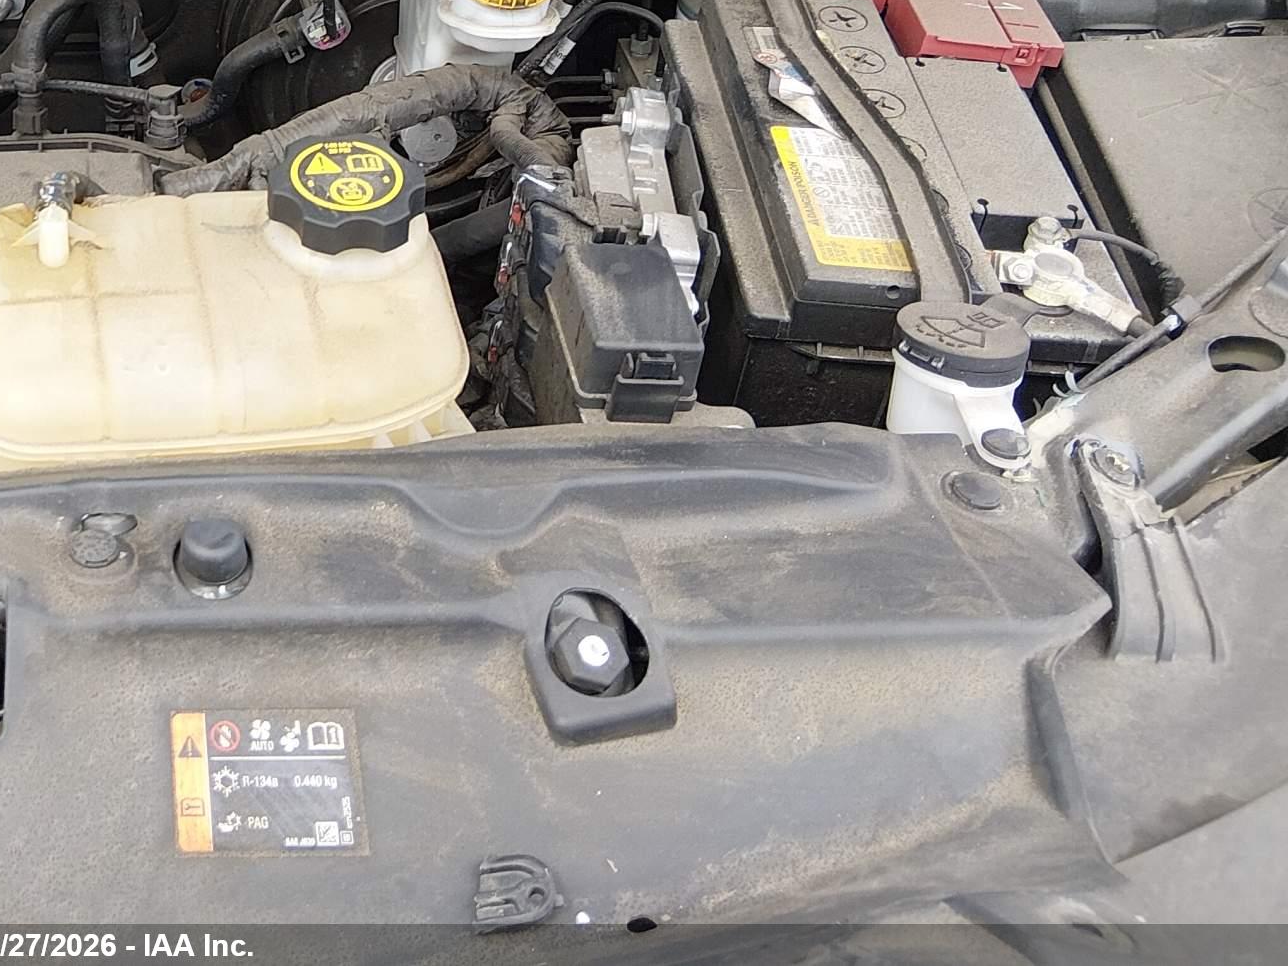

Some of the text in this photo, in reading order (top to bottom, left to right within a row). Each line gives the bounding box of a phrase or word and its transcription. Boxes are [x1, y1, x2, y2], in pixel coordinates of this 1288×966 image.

[250, 740, 275, 751] AUTO
[242, 776, 279, 788] R-134a
[324, 775, 338, 789] kg
[247, 816, 269, 829] PAG
